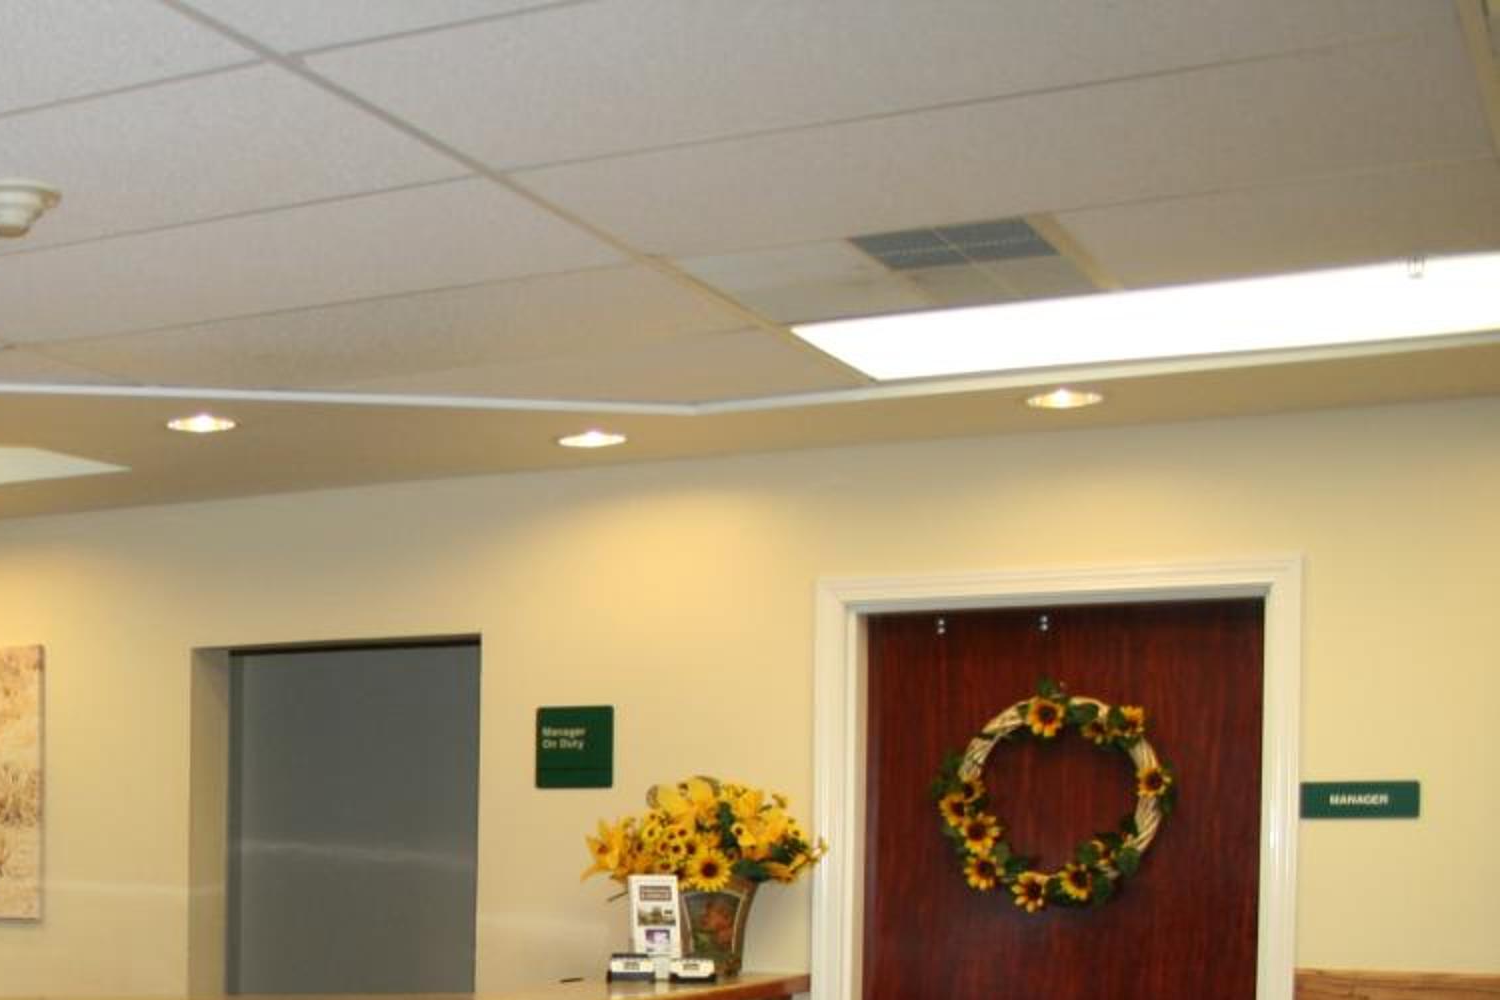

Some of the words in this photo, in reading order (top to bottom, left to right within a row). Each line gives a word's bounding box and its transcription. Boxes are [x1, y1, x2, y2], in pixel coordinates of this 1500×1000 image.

[541, 727, 586, 738] Manager
[541, 739, 557, 749] On
[560, 739, 585, 750] Duty
[1329, 794, 1389, 805] MANAGER
